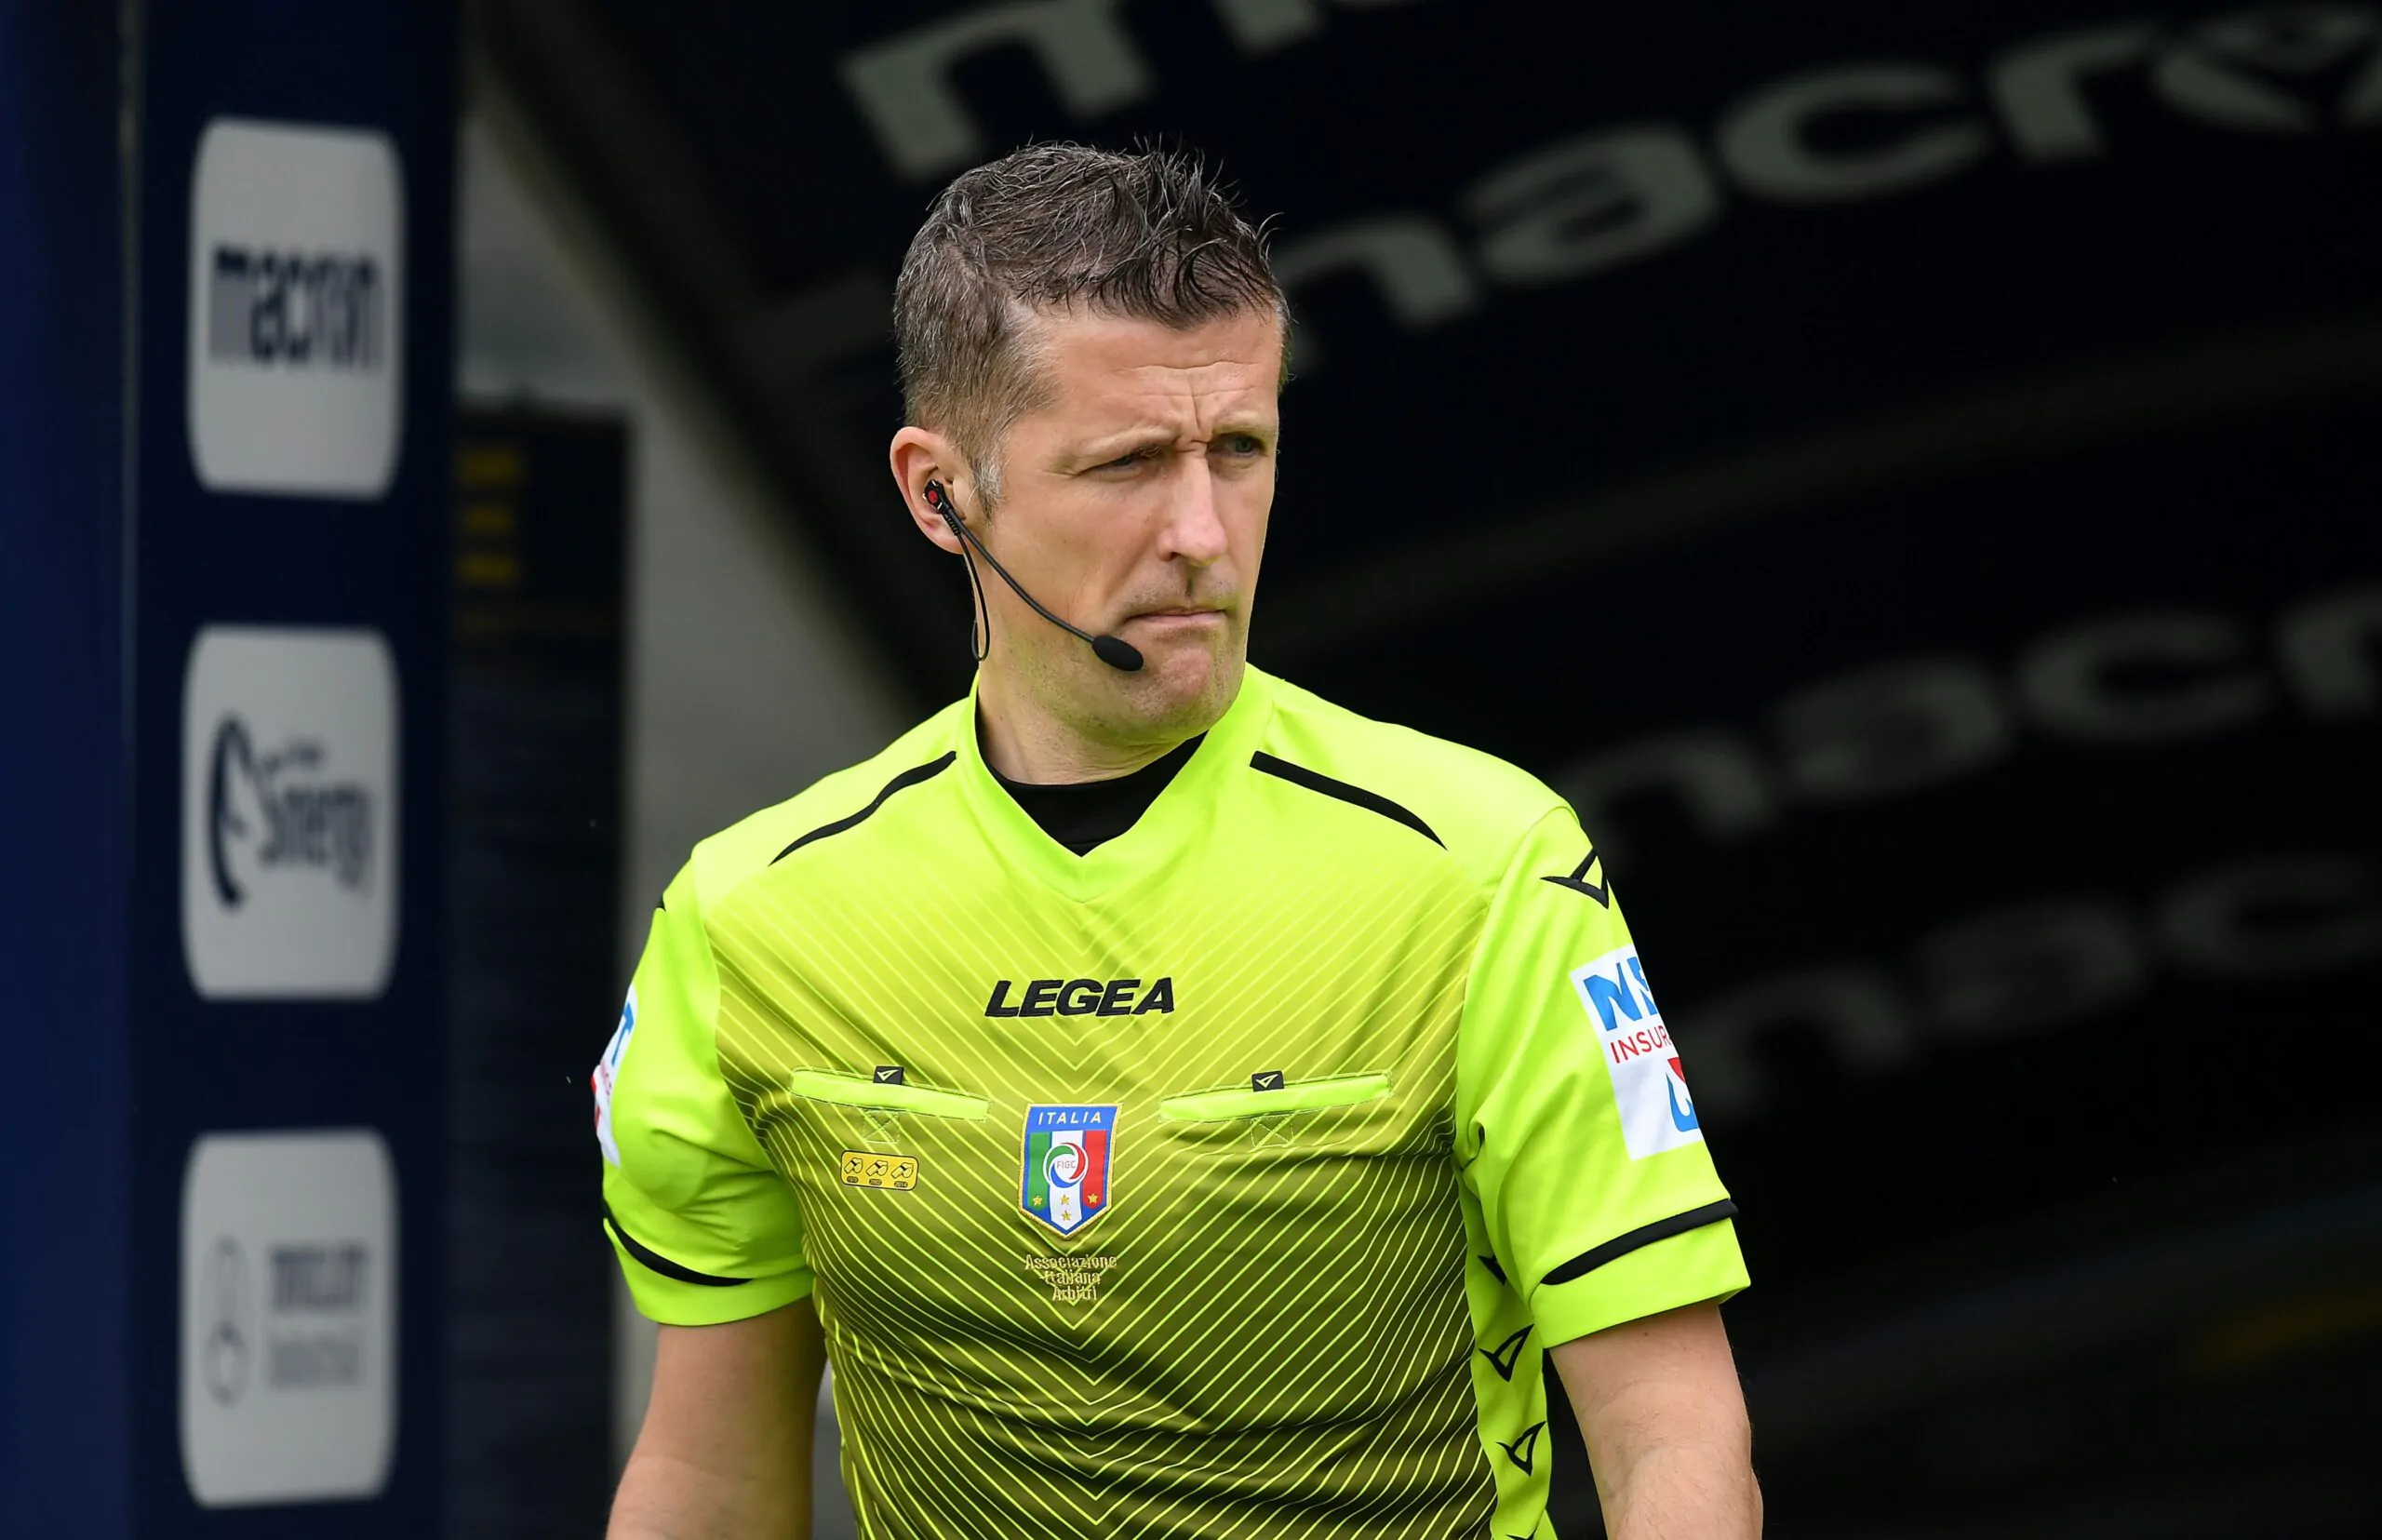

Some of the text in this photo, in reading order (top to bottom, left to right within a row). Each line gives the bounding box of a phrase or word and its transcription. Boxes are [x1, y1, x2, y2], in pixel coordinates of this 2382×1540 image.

[984, 977, 1175, 1018] LEGEA
[1037, 1111, 1102, 1126] ITALIA
[1056, 1159, 1077, 1170] FIGC
[1024, 1253, 1117, 1271] Associazione
[1041, 1269, 1101, 1285] Italiana
[1052, 1285, 1098, 1302] Arbitri
